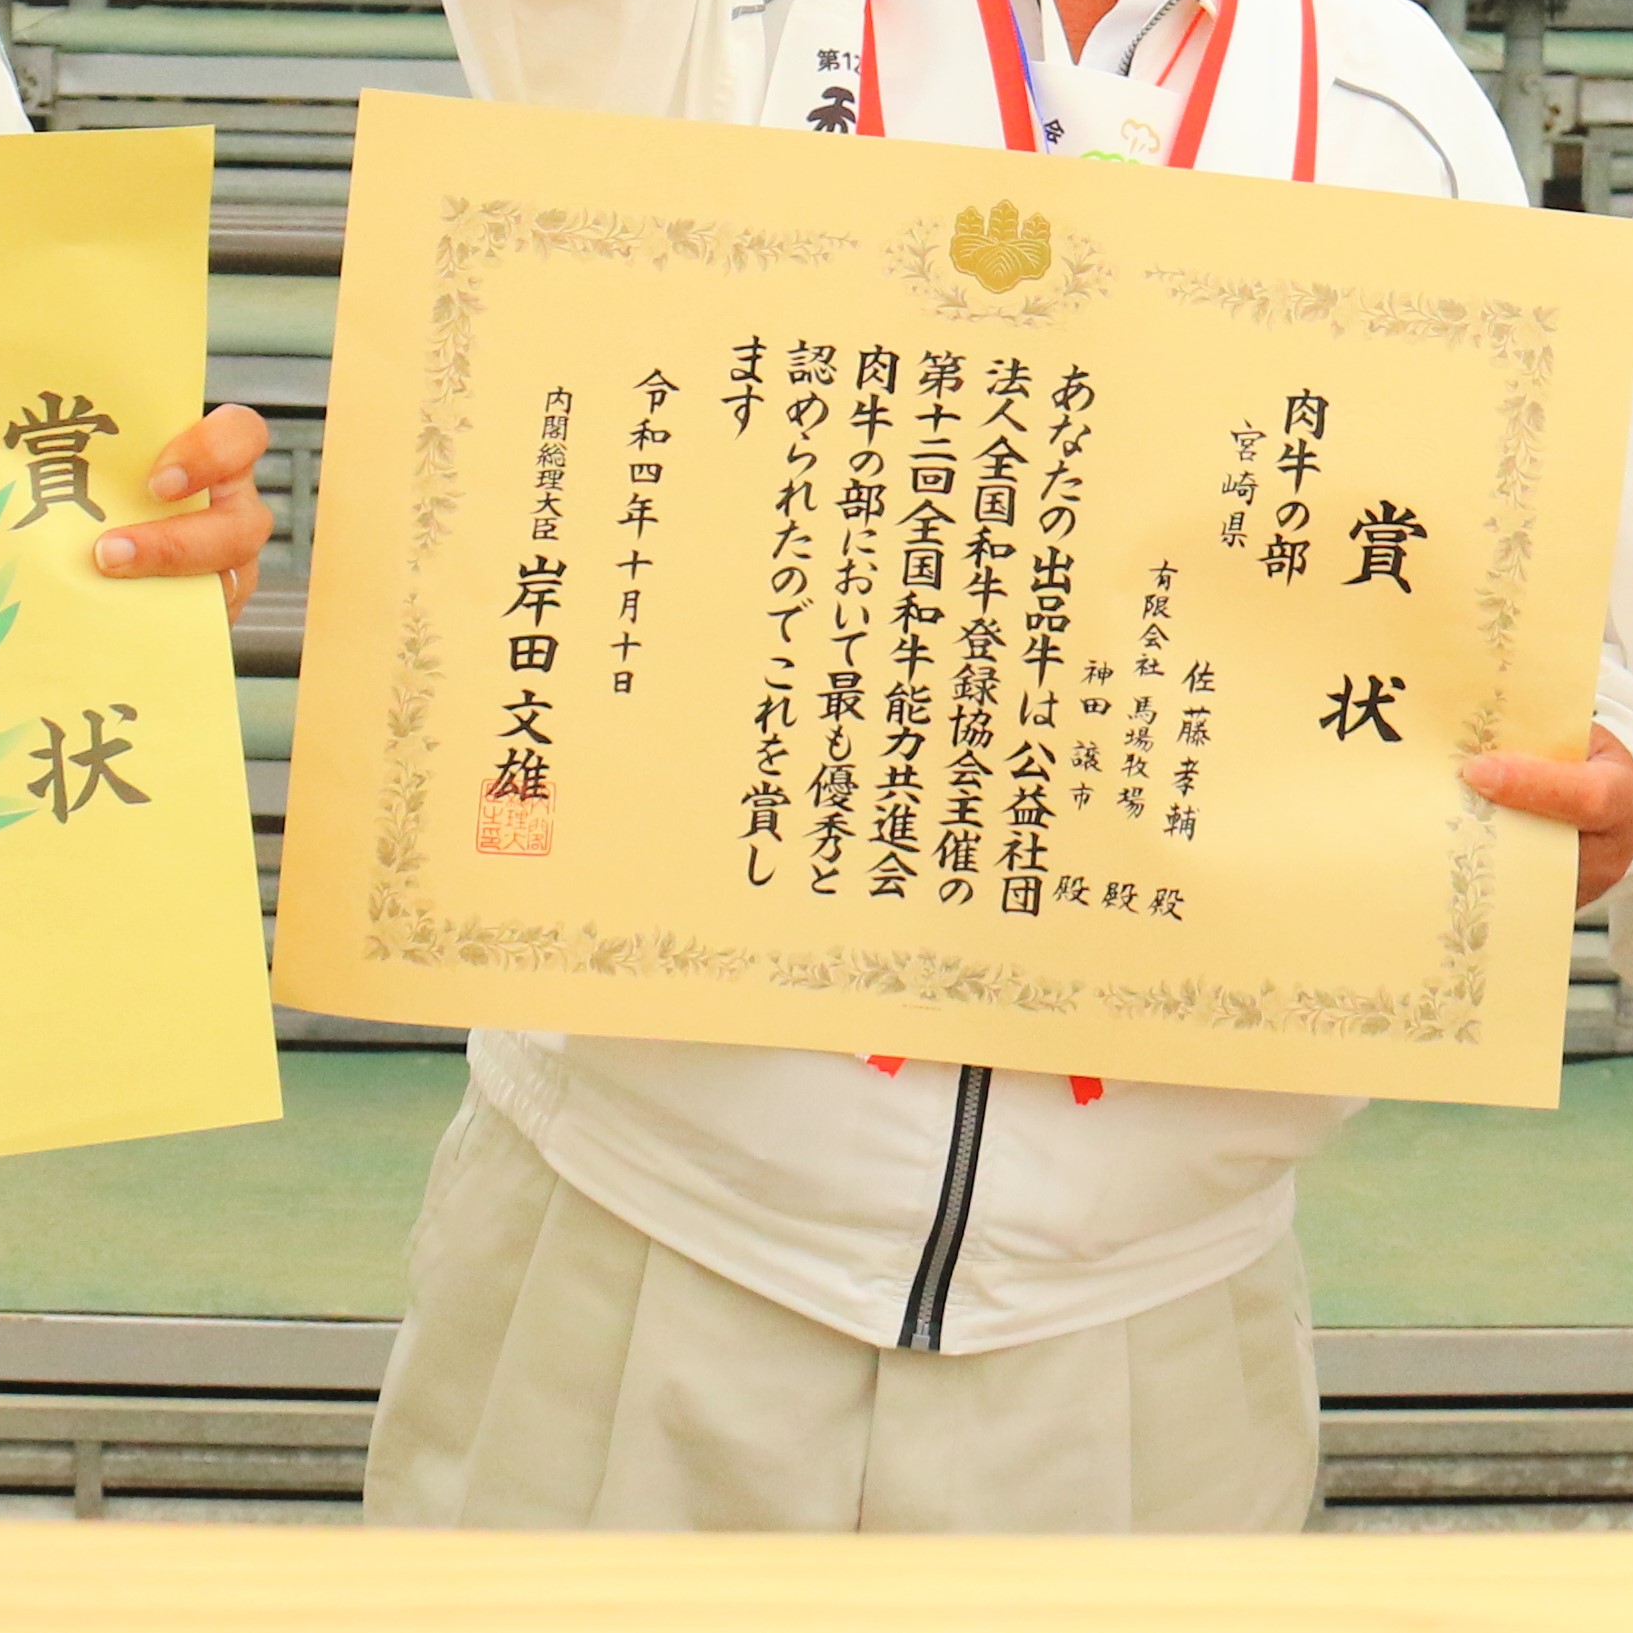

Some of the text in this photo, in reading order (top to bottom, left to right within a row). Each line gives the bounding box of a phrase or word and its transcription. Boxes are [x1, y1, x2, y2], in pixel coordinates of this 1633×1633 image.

[530, 385, 573, 542] 内閣総理大臣
[720, 335, 768, 440] ます
[1220, 419, 1268, 549] 宮崎県
[1257, 388, 1330, 587] 肉牛の部
[2, 390, 153, 825] 賞状
[609, 368, 680, 694] 令和四年十月十日
[738, 339, 837, 887] 認められたのでこれを賞し
[805, 344, 900, 896] 肉牛の部において最も優秀と
[868, 349, 967, 899] 第十二回全国和牛能力共進会
[932, 357, 1032, 907] 法人全国和牛登録協会主催の
[1001, 365, 1095, 917] あなたの出品牛は公益社団
[1134, 559, 1179, 680] 有限会社
[1318, 500, 1428, 744] 賞状
[486, 554, 567, 802] 岸田文雄
[1052, 660, 1115, 906] 神田譲市 殿
[1117, 695, 1158, 820] 馬場牧場
[1148, 659, 1216, 922] 佐藤孝輔 殿
